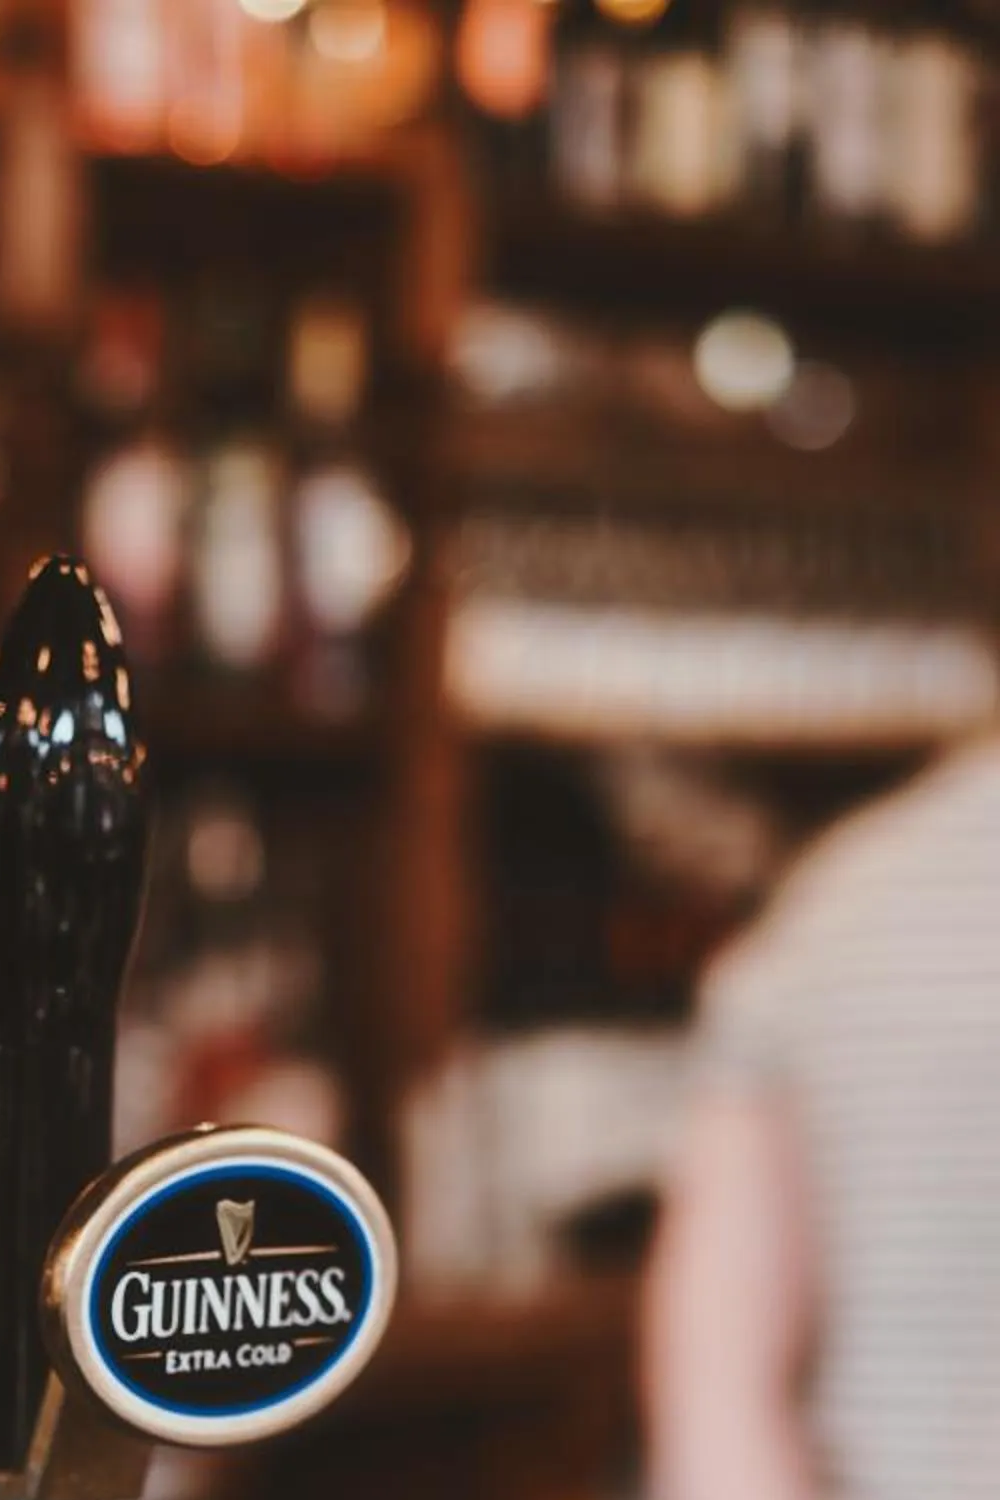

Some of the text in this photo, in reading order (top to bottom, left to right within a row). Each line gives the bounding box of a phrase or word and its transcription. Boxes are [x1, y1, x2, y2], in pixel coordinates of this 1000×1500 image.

[111, 1267, 346, 1342] GUINNESS
[165, 1343, 293, 1374] EXTRA COLD
